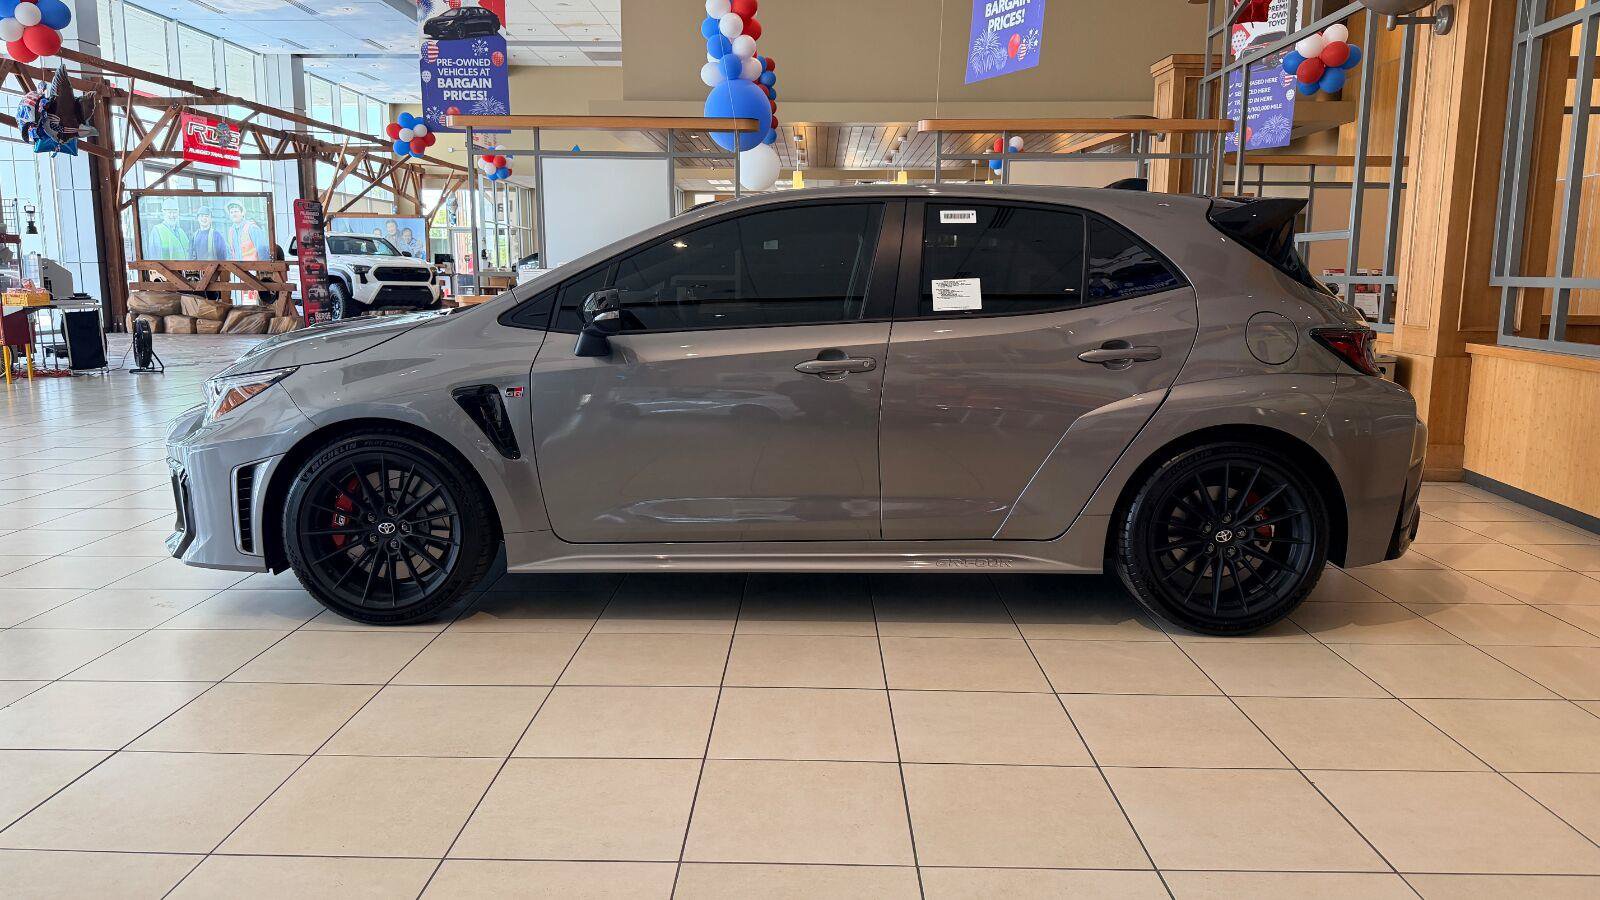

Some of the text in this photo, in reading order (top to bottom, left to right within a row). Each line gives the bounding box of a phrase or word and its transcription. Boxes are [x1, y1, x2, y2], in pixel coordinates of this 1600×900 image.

[988, 8, 1025, 32] PRICES!
[436, 58, 491, 67] PRE-OWNED
[437, 67, 491, 76] VEHICLES AT
[437, 78, 492, 88] BARGAIN
[443, 90, 488, 101] PRICES!
